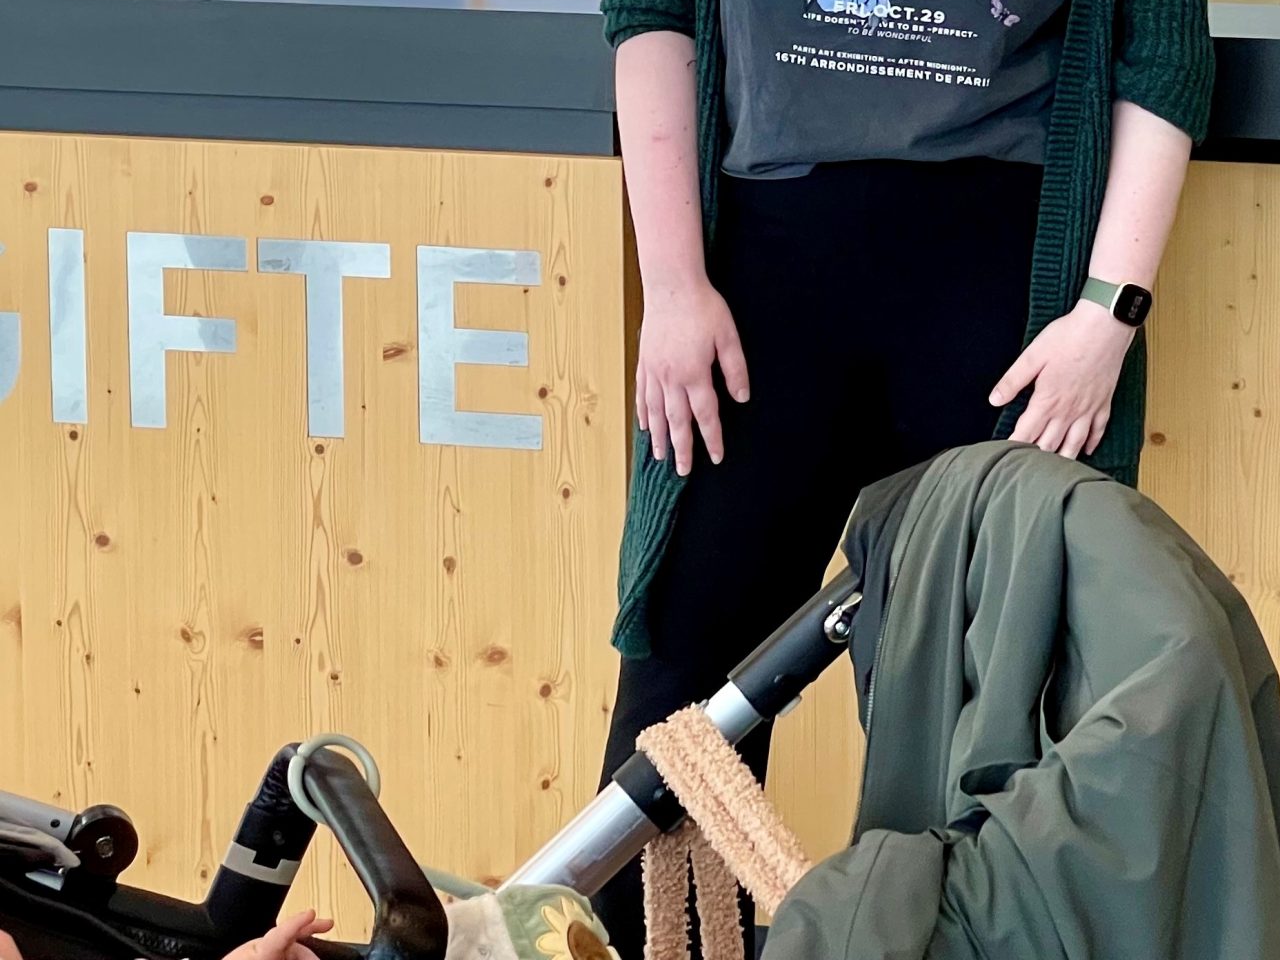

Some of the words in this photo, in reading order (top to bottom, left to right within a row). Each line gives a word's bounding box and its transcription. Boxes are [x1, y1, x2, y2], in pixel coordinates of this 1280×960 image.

[847, 27, 860, 36] TO
[876, 30, 933, 44] WONDERFUL
[897, 21, 910, 31] TO
[911, 24, 925, 33] BE
[774, 51, 807, 66] 16TH
[809, 54, 932, 82] ARRONDISSEMENT
[935, 72, 952, 85] DE
[792, 43, 817, 55] PARIS
[818, 48, 835, 58] ART
[898, 57, 925, 68] AFTER
[0, 226, 543, 451] IFTE
